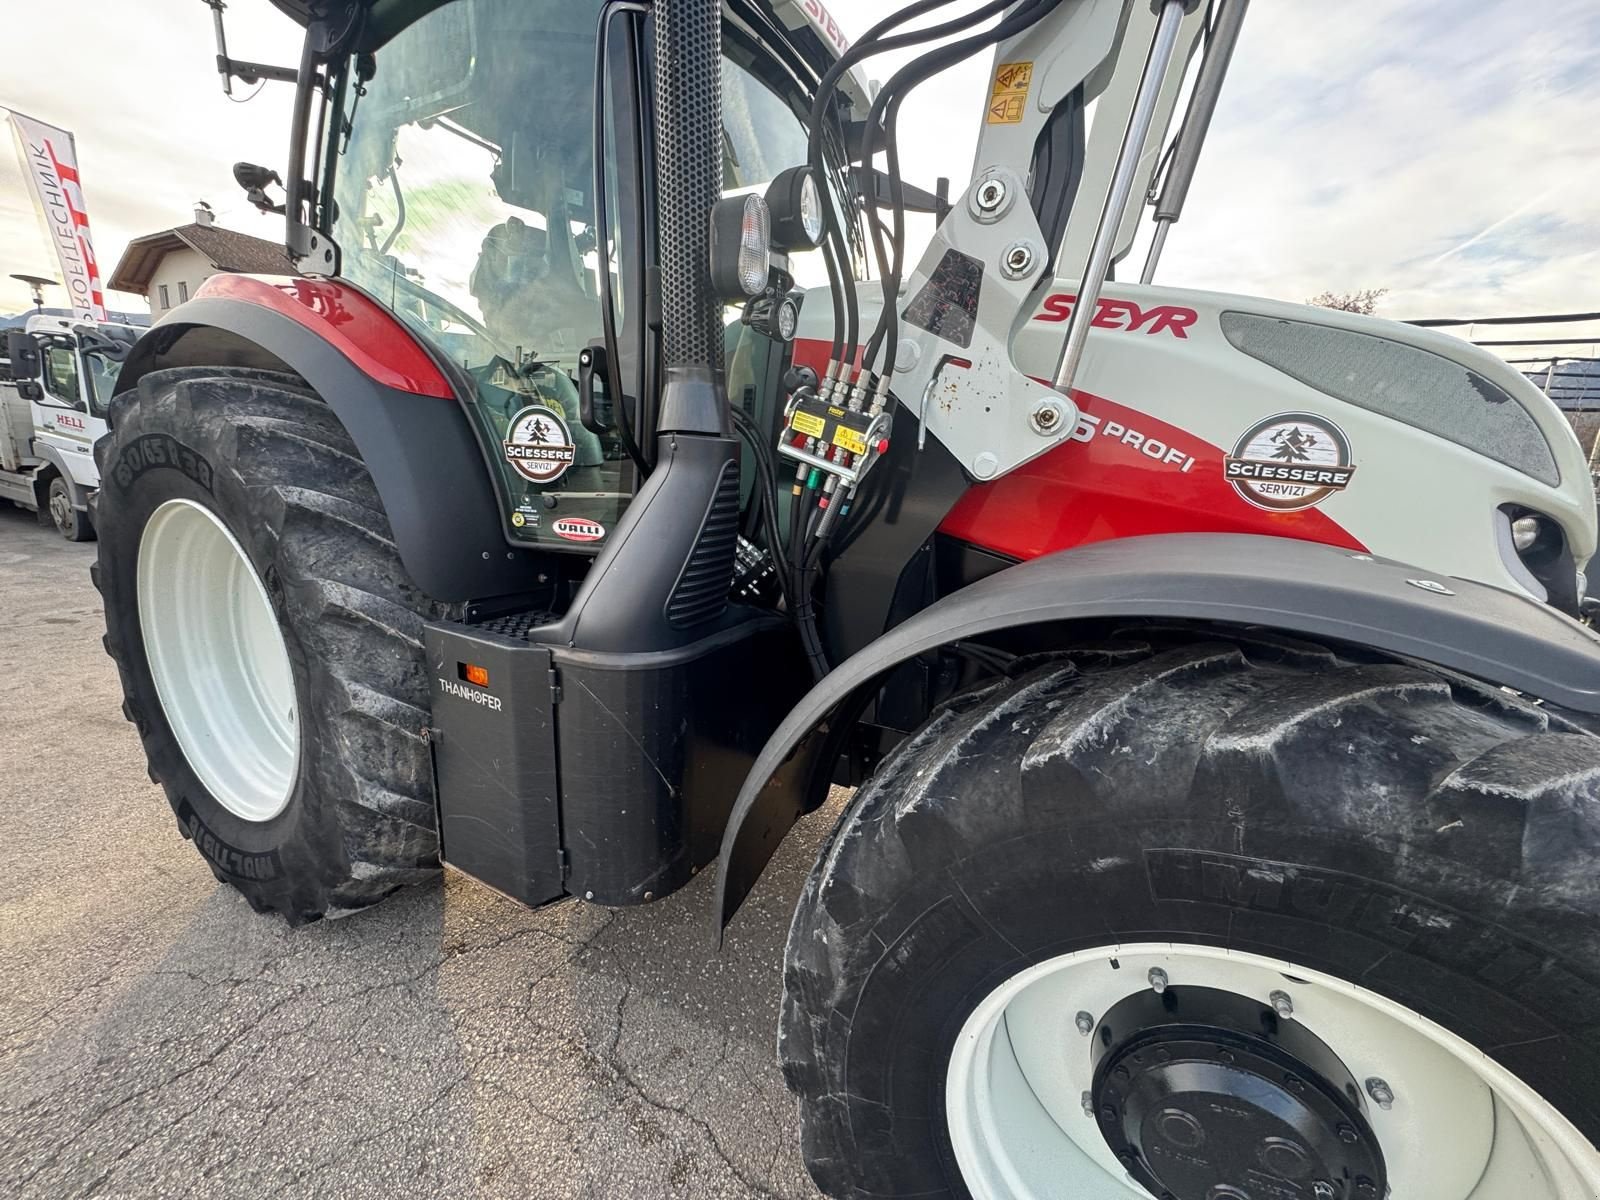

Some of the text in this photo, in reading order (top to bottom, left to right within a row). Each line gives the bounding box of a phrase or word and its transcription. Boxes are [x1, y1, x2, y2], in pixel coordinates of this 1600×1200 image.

[1032, 294, 1198, 339] SEYR
[56, 414, 86, 429] HELL
[1102, 421, 1196, 473] PROFI
[527, 461, 552, 471] SERVIZI
[1259, 483, 1306, 497] SERVIZI
[558, 523, 600, 535] VALLI
[438, 678, 502, 712] THANHOFER
